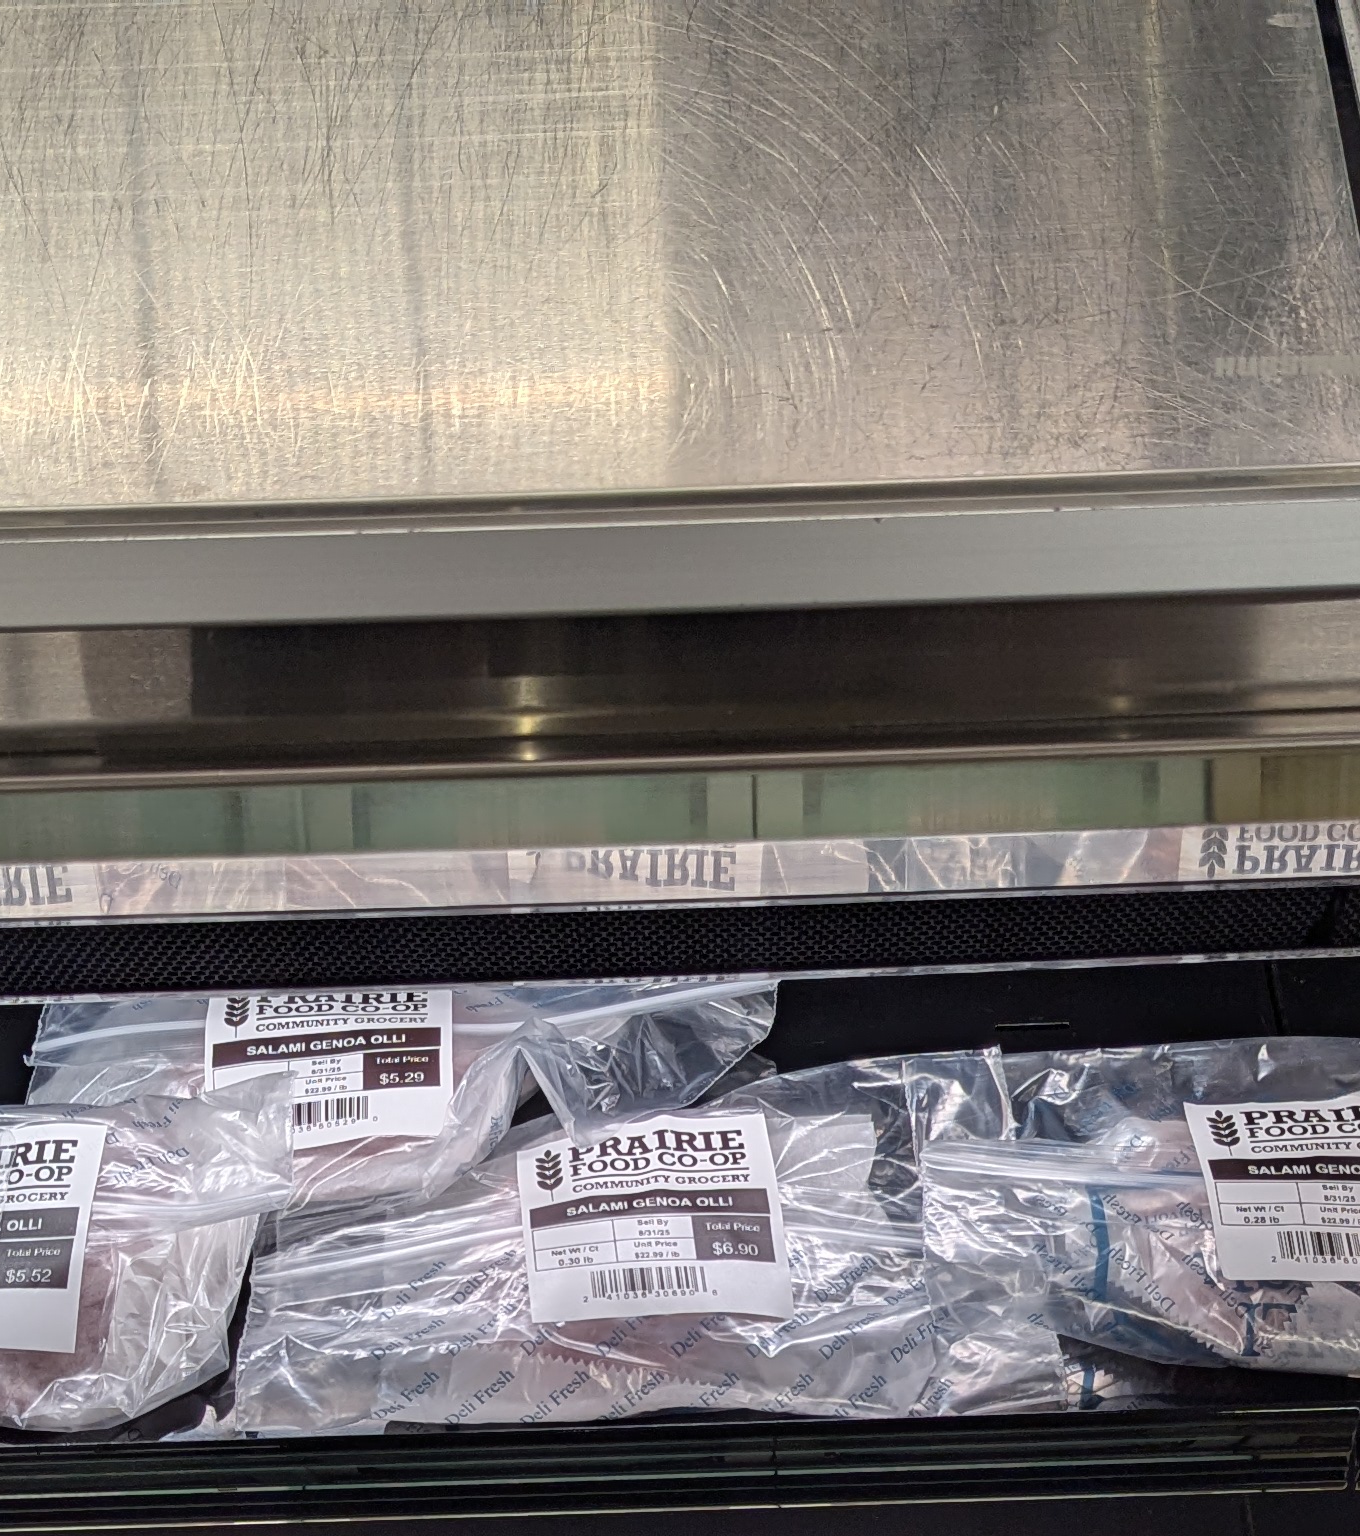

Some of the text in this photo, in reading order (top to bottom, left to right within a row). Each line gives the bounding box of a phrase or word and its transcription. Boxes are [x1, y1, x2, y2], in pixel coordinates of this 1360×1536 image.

[256, 1002, 428, 1017] FOOD CO-OP
[256, 1016, 427, 1032] COMMUNITY GROCERY
[247, 1034, 405, 1056] SALAMI GENOA OLLI
[380, 1072, 425, 1085] $5.29
[1246, 1124, 1329, 1138] FOOD
[569, 1129, 745, 1162] PRAIRIE
[1250, 1142, 1351, 1153] COMMUNITY
[569, 1152, 746, 1176] FOOD CO-OP
[1248, 1164, 1311, 1175] SALAMI
[573, 1173, 750, 1193] COMMUNITY GROCERY
[567, 1197, 733, 1217] SALAMI GENOA OLLI
[7, 1218, 42, 1231] OLLI
[712, 1242, 758, 1257] $6.90
[5, 1268, 52, 1283] $5.52
